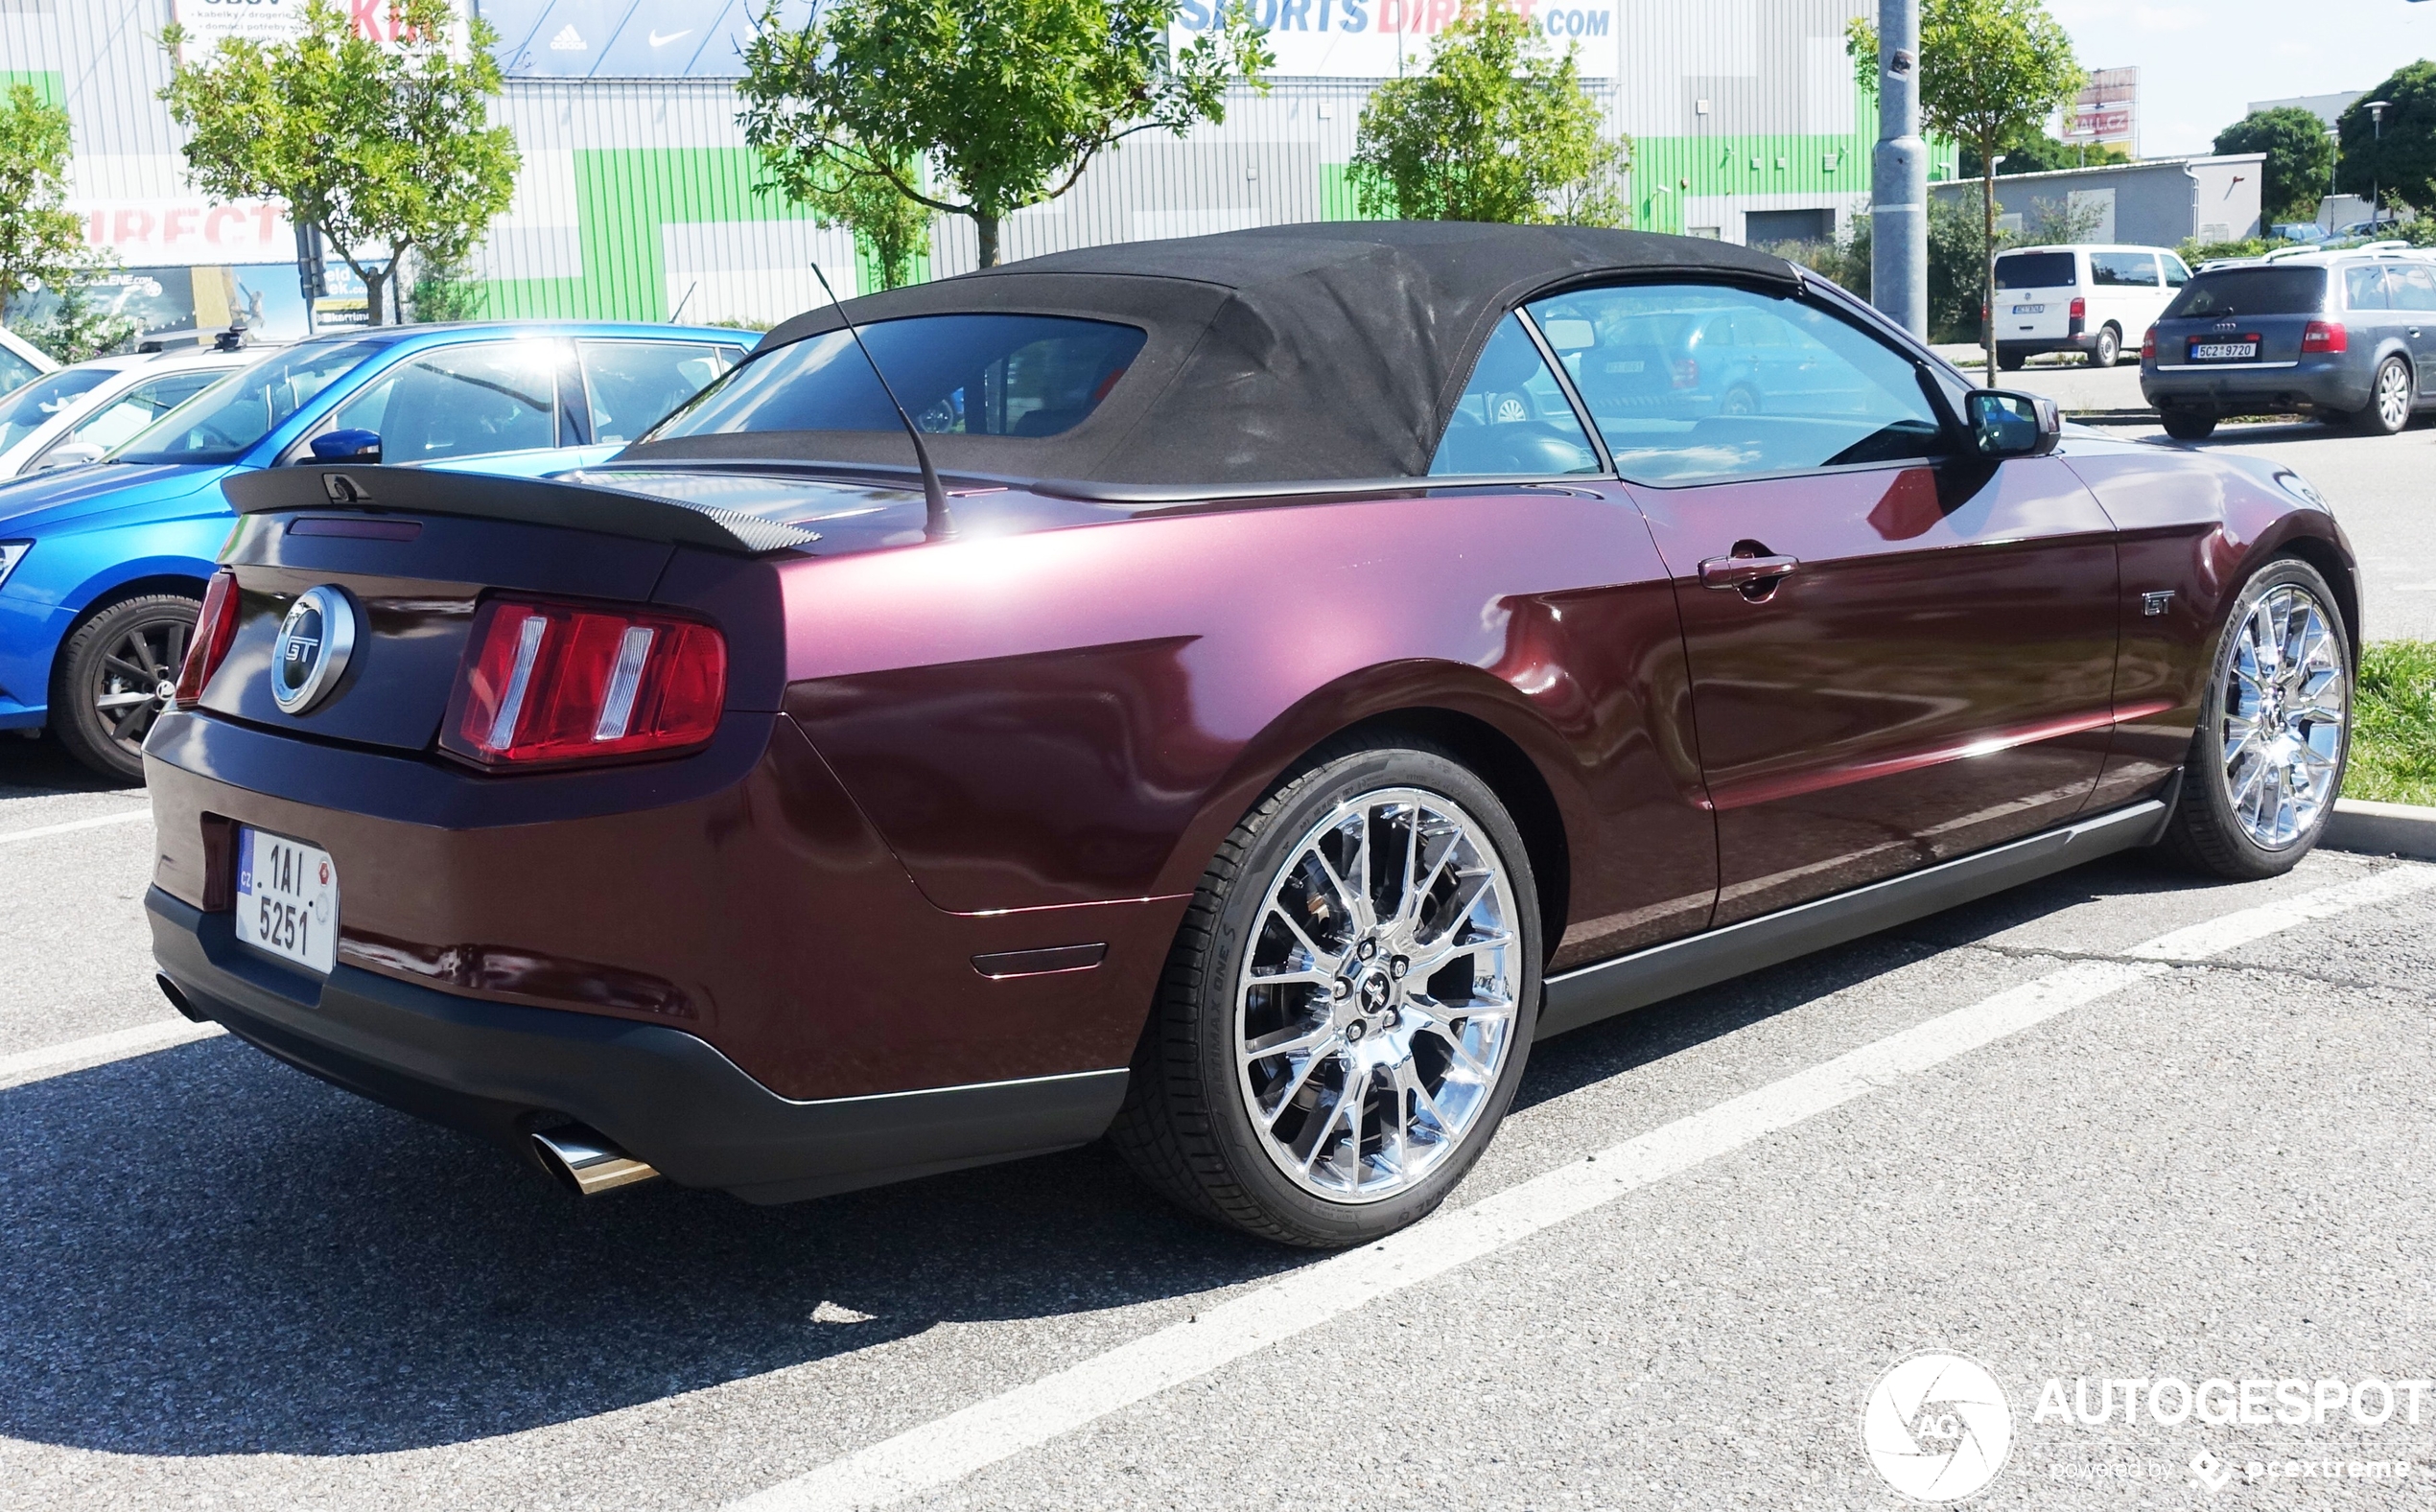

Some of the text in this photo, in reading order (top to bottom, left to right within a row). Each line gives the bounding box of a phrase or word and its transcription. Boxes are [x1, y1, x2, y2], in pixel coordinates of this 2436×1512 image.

[550, 39, 588, 50] adidas
[2200, 345, 2251, 357] 5C2 9720
[286, 635, 319, 663] GT
[241, 871, 251, 888] CZ
[270, 844, 303, 897] 1AI
[259, 896, 308, 957] 5251
